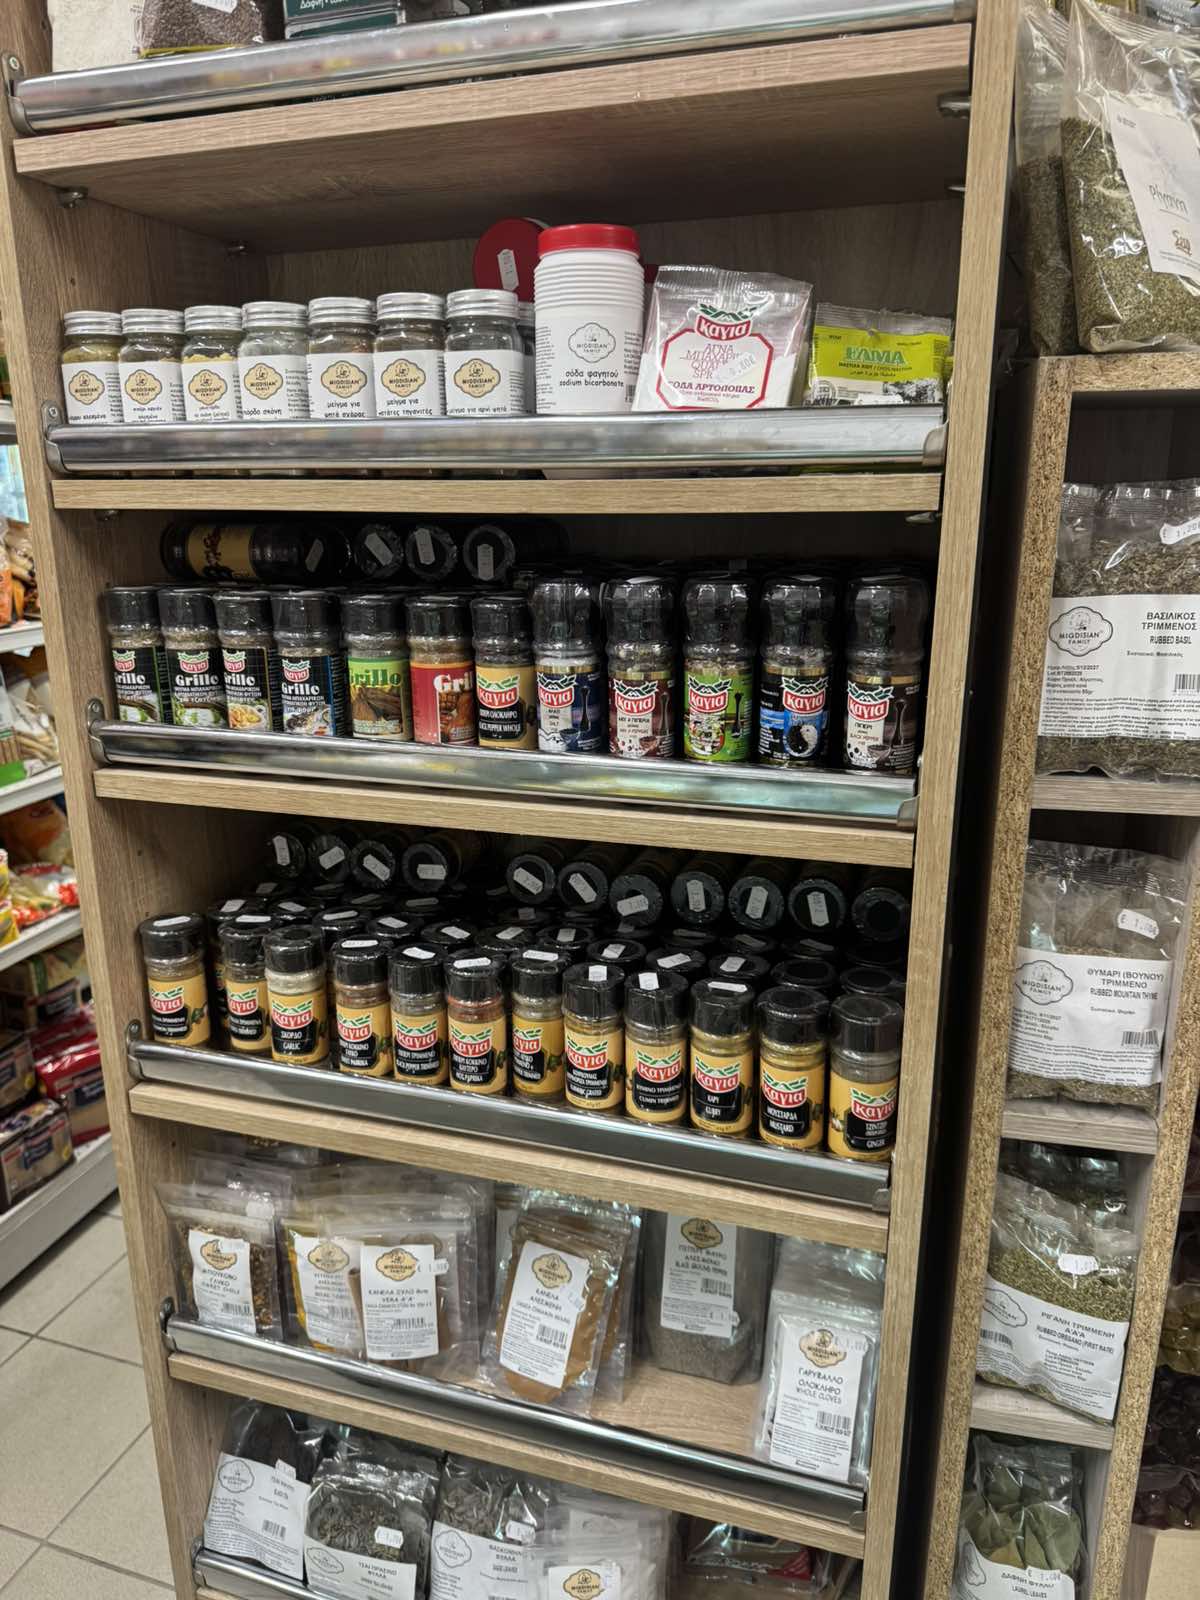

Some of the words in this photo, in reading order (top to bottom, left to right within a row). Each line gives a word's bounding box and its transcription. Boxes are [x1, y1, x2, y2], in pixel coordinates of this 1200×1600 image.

[565, 368, 584, 378] σόδα
[586, 369, 619, 379] φαγητού
[584, 379, 625, 387] bicarbonate
[1146, 611, 1196, 620] ΒΑΣΙΛΙΚΟΣ
[1141, 622, 1198, 631] ΤΡΙΜΜΕΝΟΣ
[1150, 635, 1174, 645] RUBBED
[1175, 635, 1192, 644] BASIL
[116, 673, 146, 684] rillo
[175, 674, 219, 686] Grillo
[351, 669, 402, 688] rillo
[281, 682, 320, 695] Grillo
[1087, 968, 1121, 978] ΘΥΜΑΡΙ
[1122, 970, 1164, 982] (ΒΟΥΝΟΥ)
[1101, 979, 1148, 989] ΤΡΙΜΜΕΝΟ
[1090, 987, 1112, 997] RUBBED
[1113, 989, 1142, 999] MOUNTAIN
[283, 1042, 301, 1050] GARLIC
[769, 1121, 794, 1133] MUSTARD
[866, 1139, 885, 1148] GINGER
[1041, 1311, 1071, 1326] ΡΙΓΑΝΗ
[1072, 1321, 1115, 1339] ΤΡΙΜΜΕΝΗ
[818, 1392, 842, 1405] CLOVES
